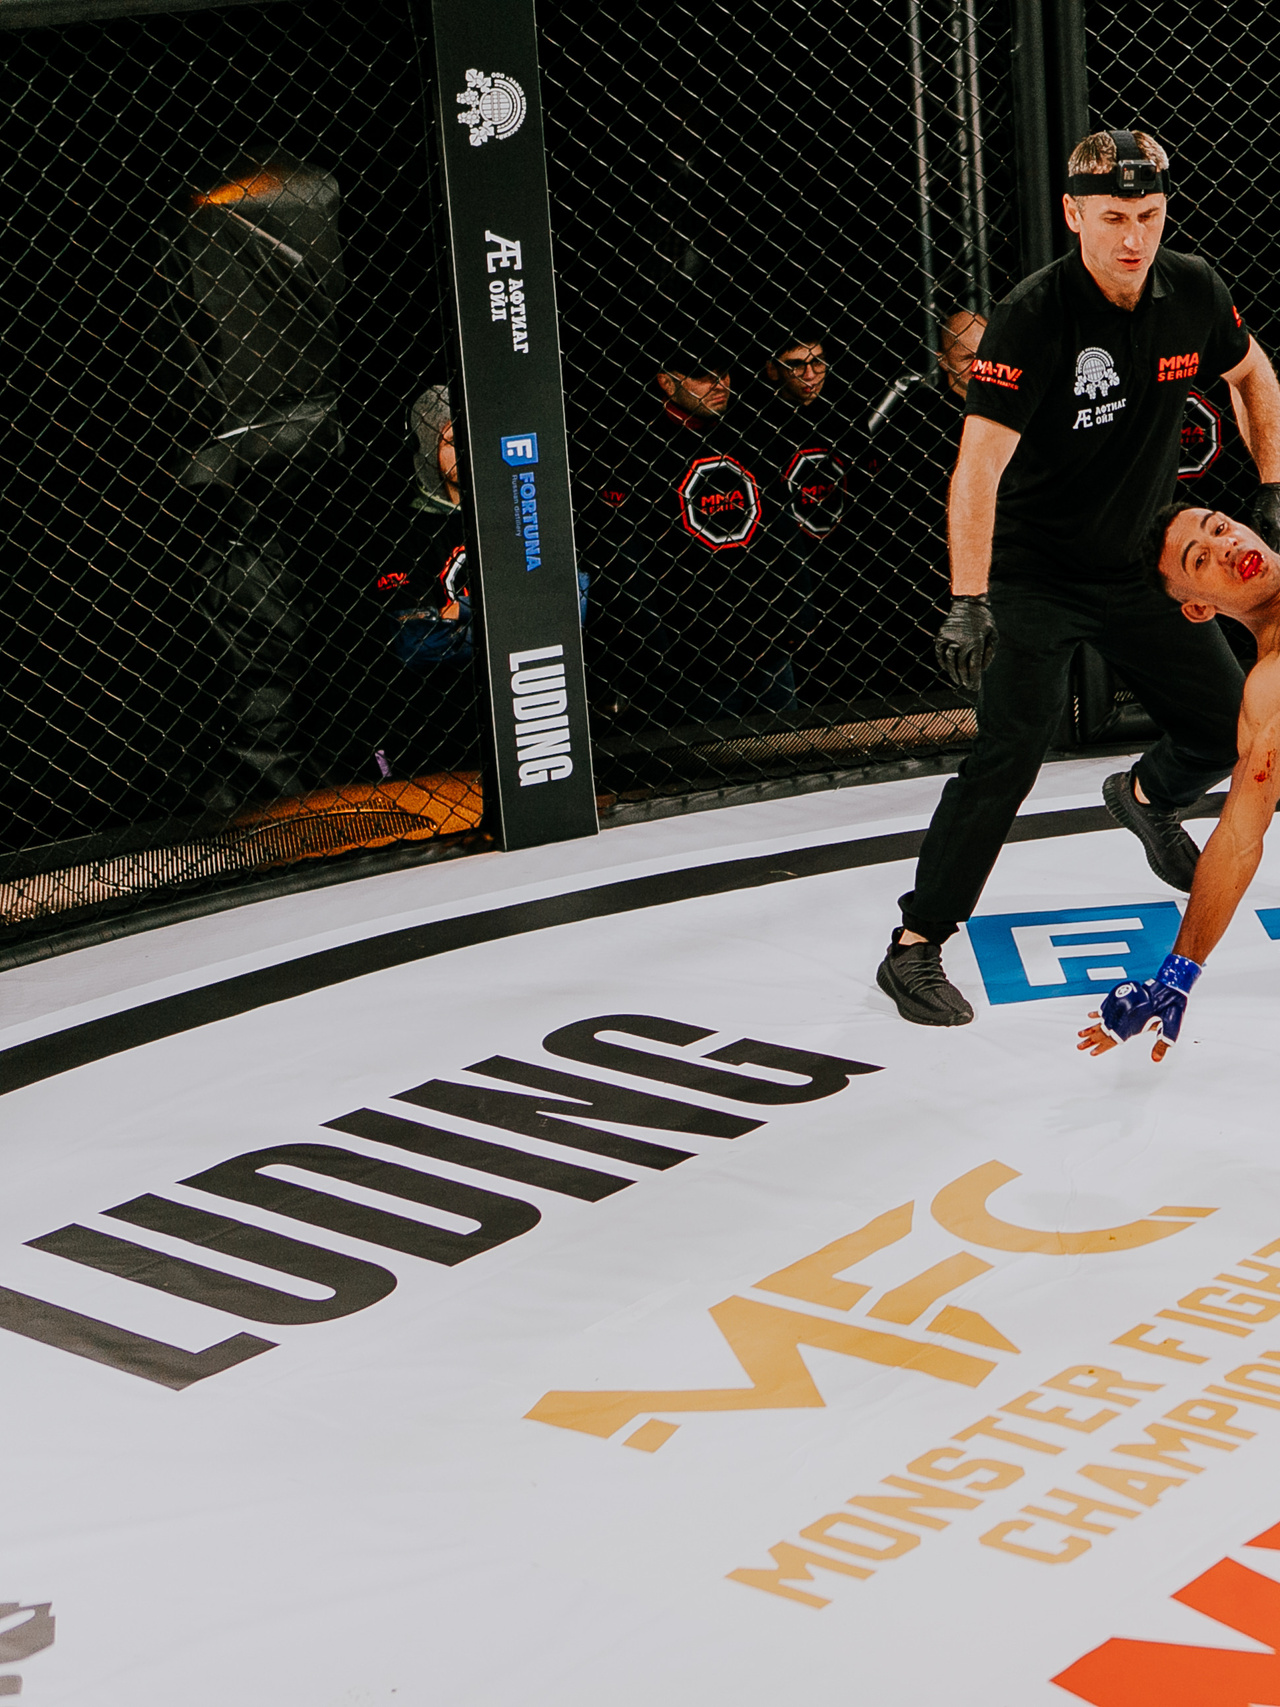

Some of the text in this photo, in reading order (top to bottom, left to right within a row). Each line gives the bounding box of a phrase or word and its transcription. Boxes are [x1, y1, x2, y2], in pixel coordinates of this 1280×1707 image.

[488, 280, 507, 322] ОЙЛ
[508, 278, 529, 354] АФТИАГ
[1157, 366, 1198, 382] SERIES
[1158, 352, 1200, 371] MMA
[518, 471, 542, 572] FORTUNA
[509, 644, 574, 787] LUDING
[0, 1013, 887, 1392] LUDING
[522, 1159, 1220, 1453] MFC
[724, 1364, 1168, 1610] MONSTER
